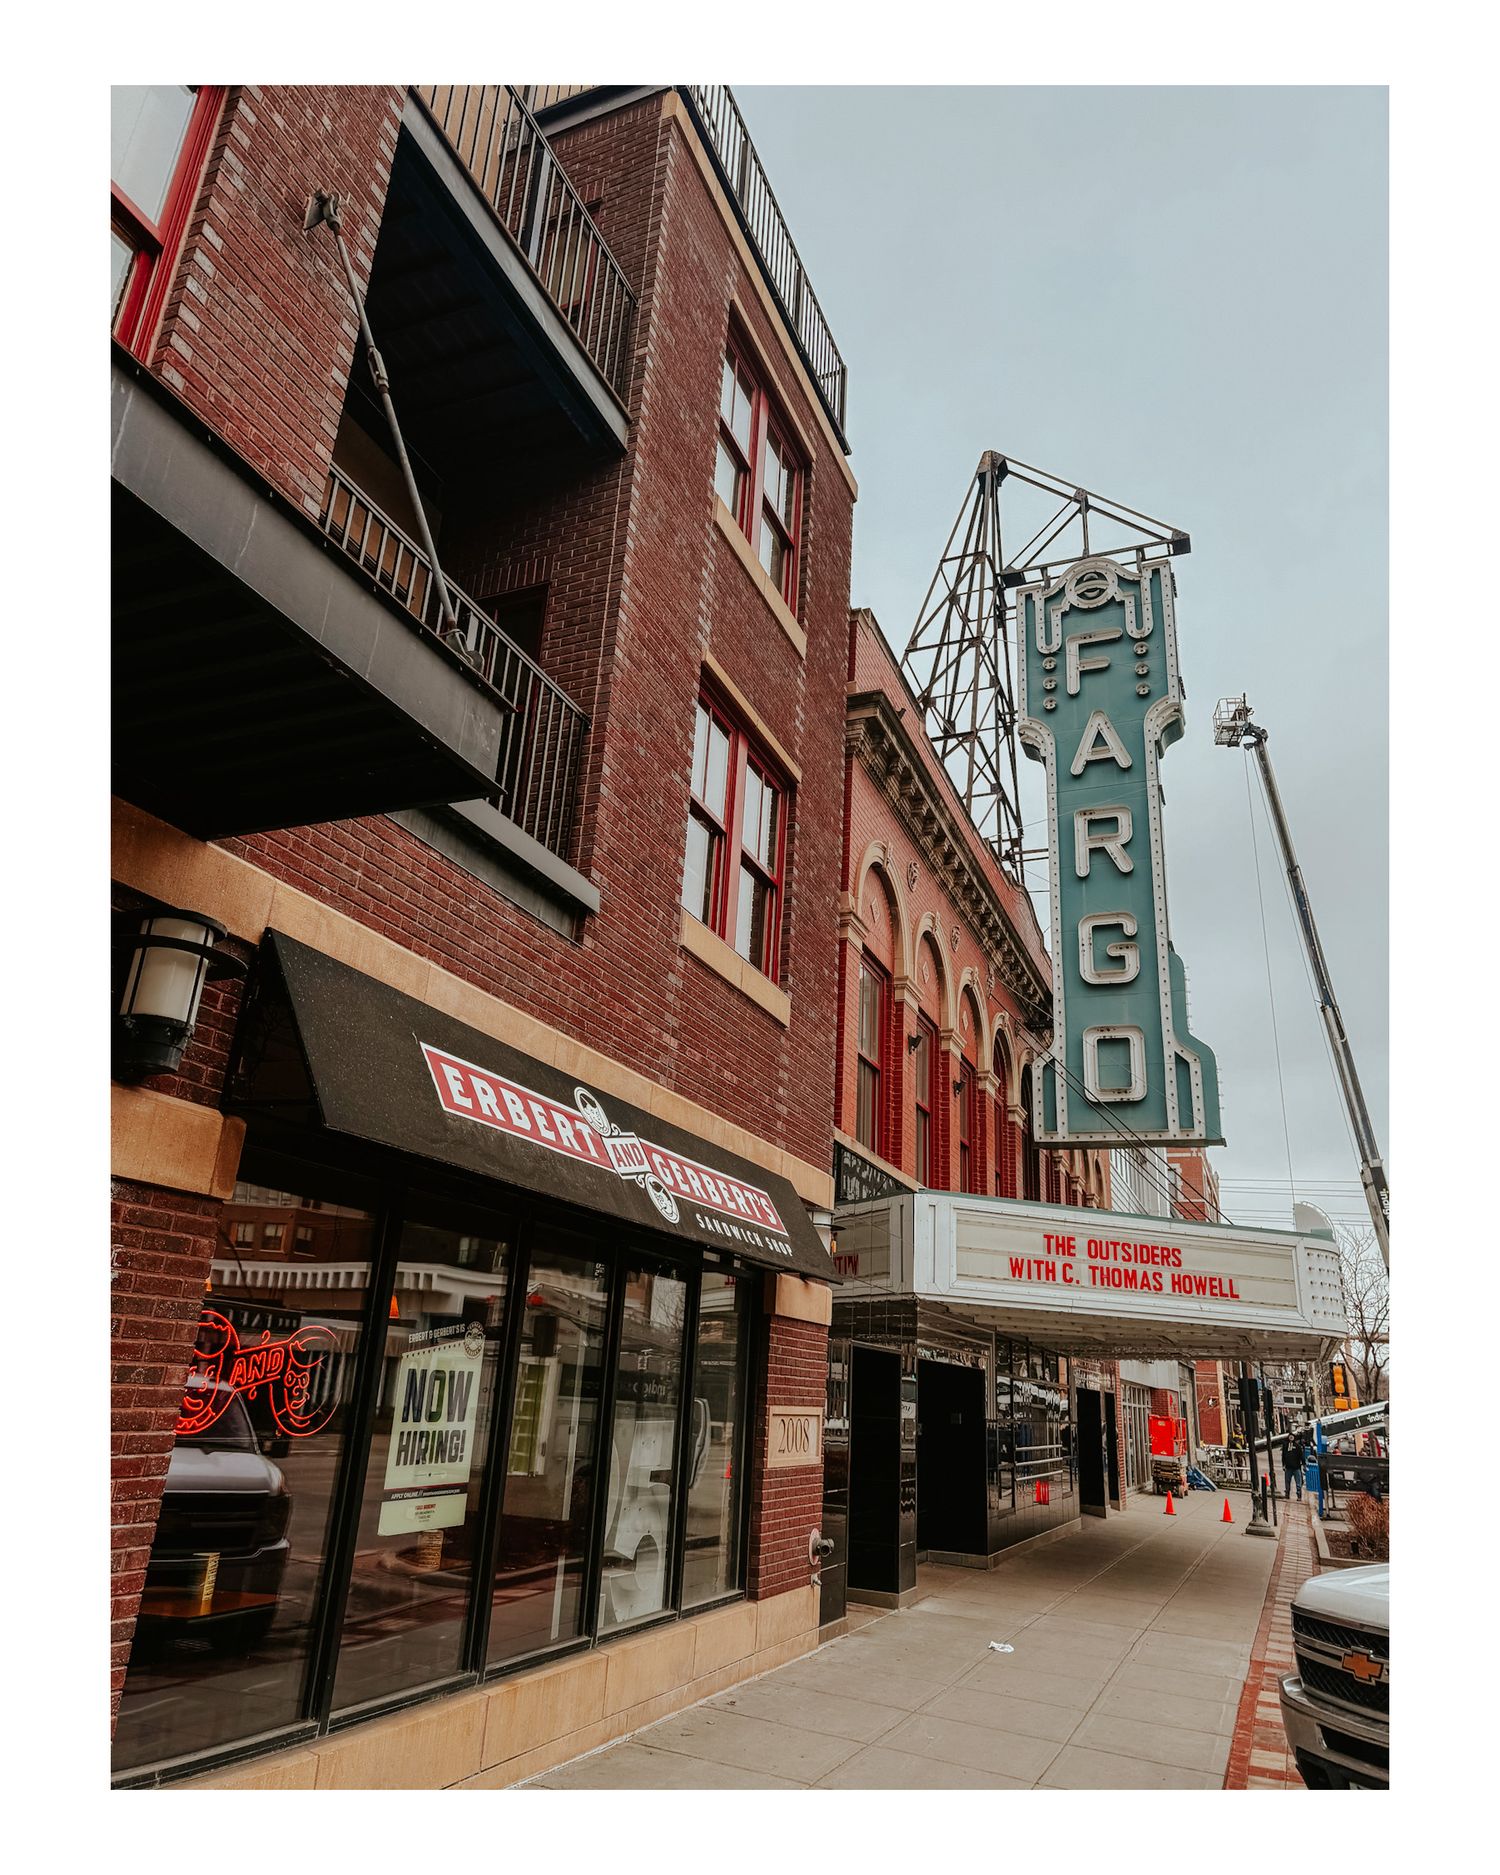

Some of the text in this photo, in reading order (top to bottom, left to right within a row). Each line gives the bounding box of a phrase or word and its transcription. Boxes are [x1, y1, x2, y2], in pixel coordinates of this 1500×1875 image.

[1065, 627, 1148, 1102] FARGO
[440, 1062, 777, 1225] ERBERT AND GERBERT'S
[695, 1213, 793, 1257] SANDWICH SHOP
[1043, 1234, 1182, 1268] THE OUTSIDERS
[1009, 1257, 1240, 1299] WITH C. THOMAS HOWELL
[229, 1347, 285, 1386] AND
[401, 1368, 474, 1423] NOW
[395, 1429, 467, 1467] HIRING!
[778, 1418, 810, 1454] 2008
